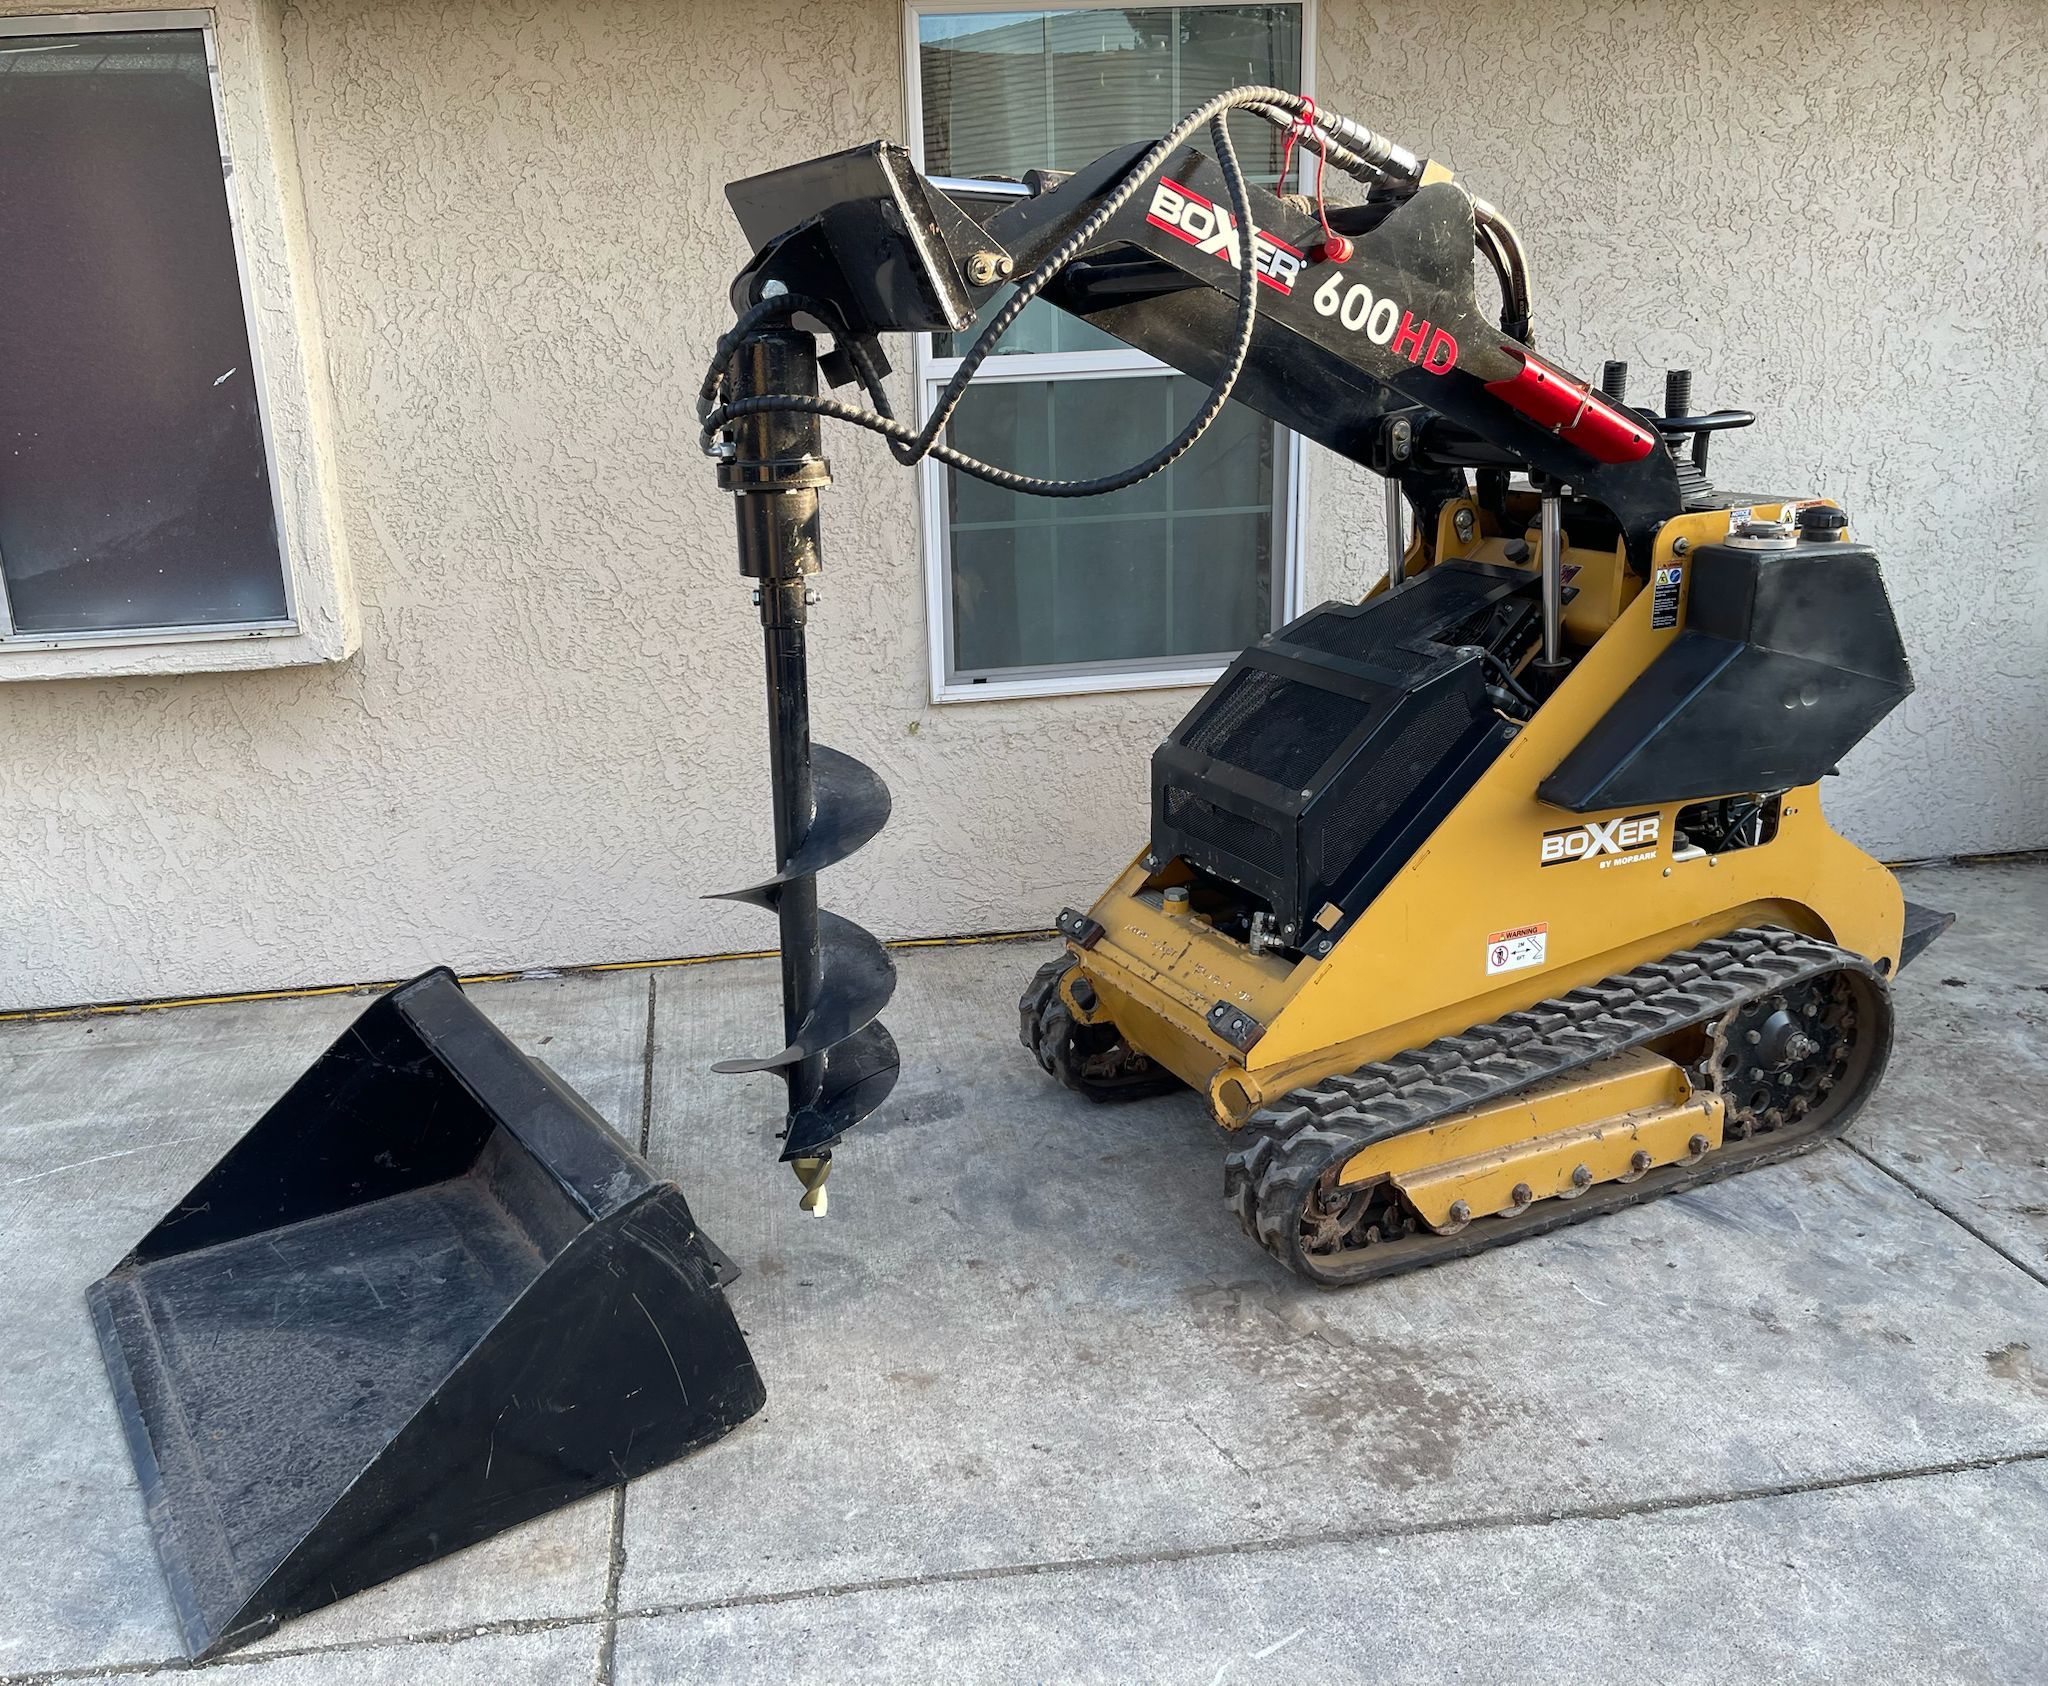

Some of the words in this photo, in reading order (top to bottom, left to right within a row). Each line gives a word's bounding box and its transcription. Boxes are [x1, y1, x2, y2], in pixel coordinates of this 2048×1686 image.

[1148, 182, 1302, 288] BOXER
[1312, 270, 1459, 377] 600HD
[1541, 817, 1660, 861] BOXER
[1599, 859, 1611, 869] BY
[1613, 850, 1657, 867] MORBARK
[1506, 926, 1538, 939] WARNING
